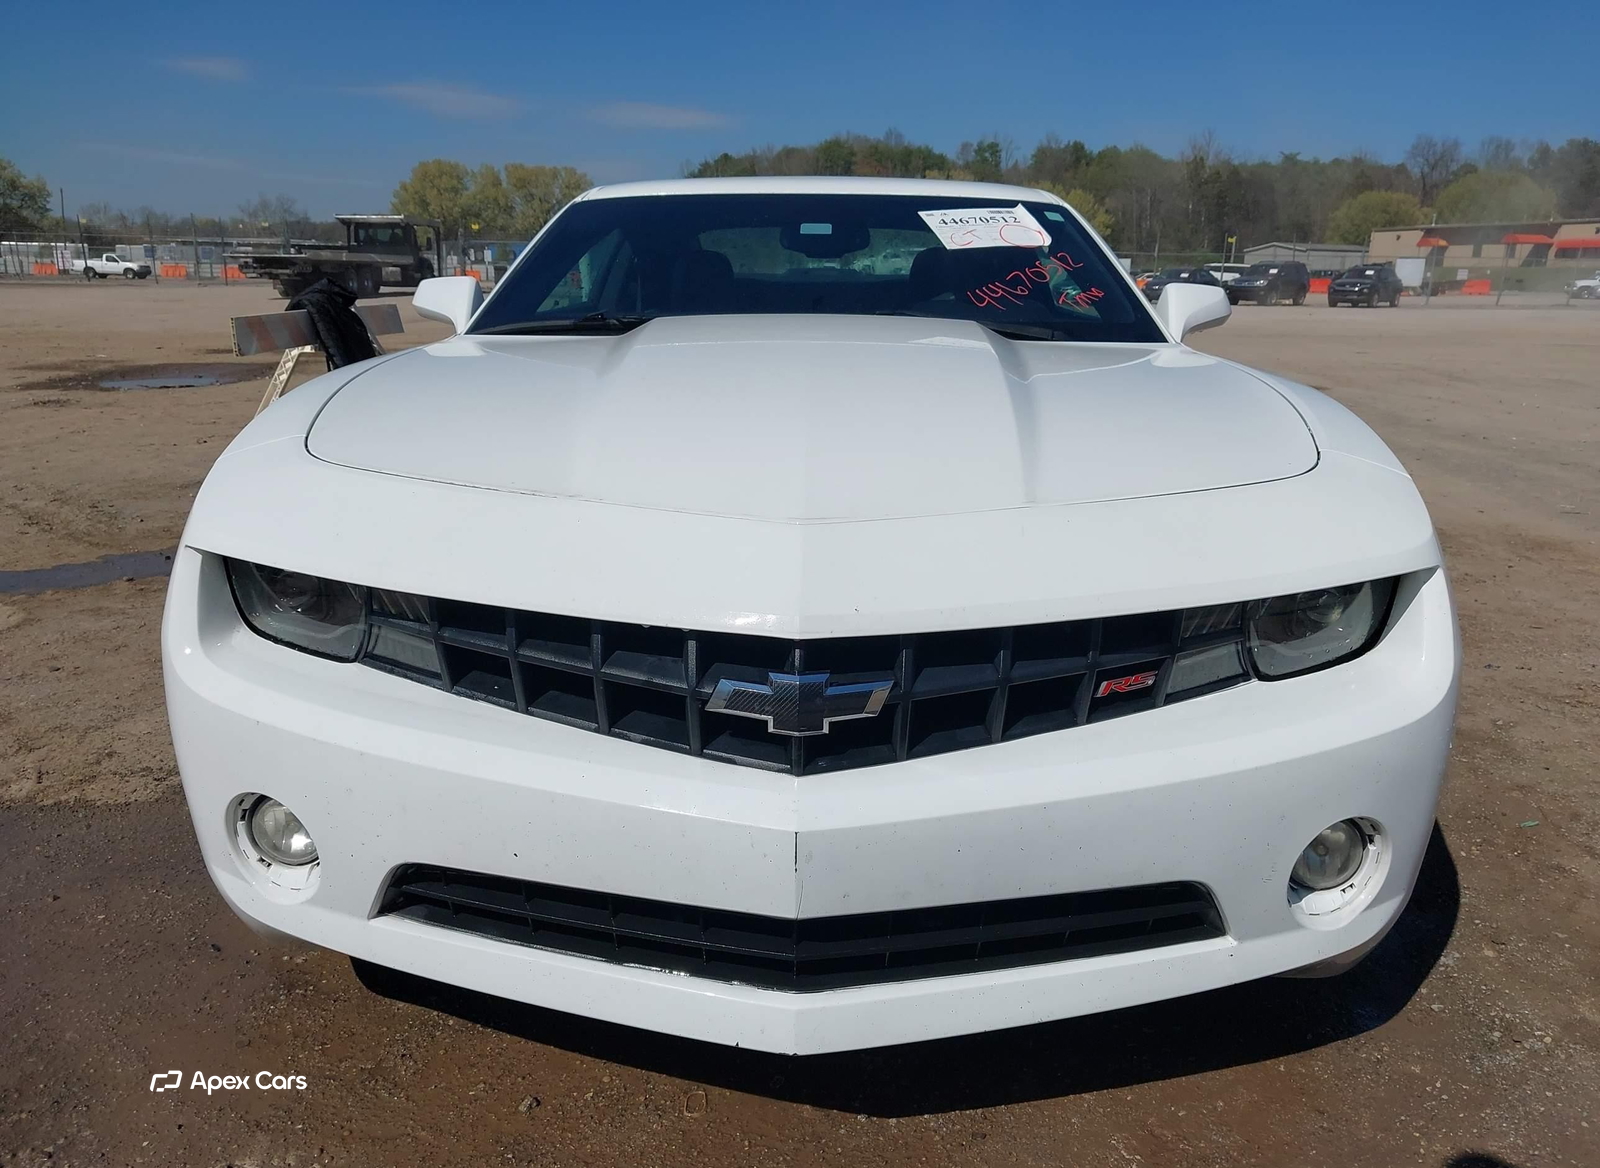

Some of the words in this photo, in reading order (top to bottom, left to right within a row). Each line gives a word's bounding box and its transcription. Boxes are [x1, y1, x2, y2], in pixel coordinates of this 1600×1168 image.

[938, 215, 1021, 226] 44670512
[967, 252, 1084, 311] 44670512
[1094, 670, 1159, 698] RS
